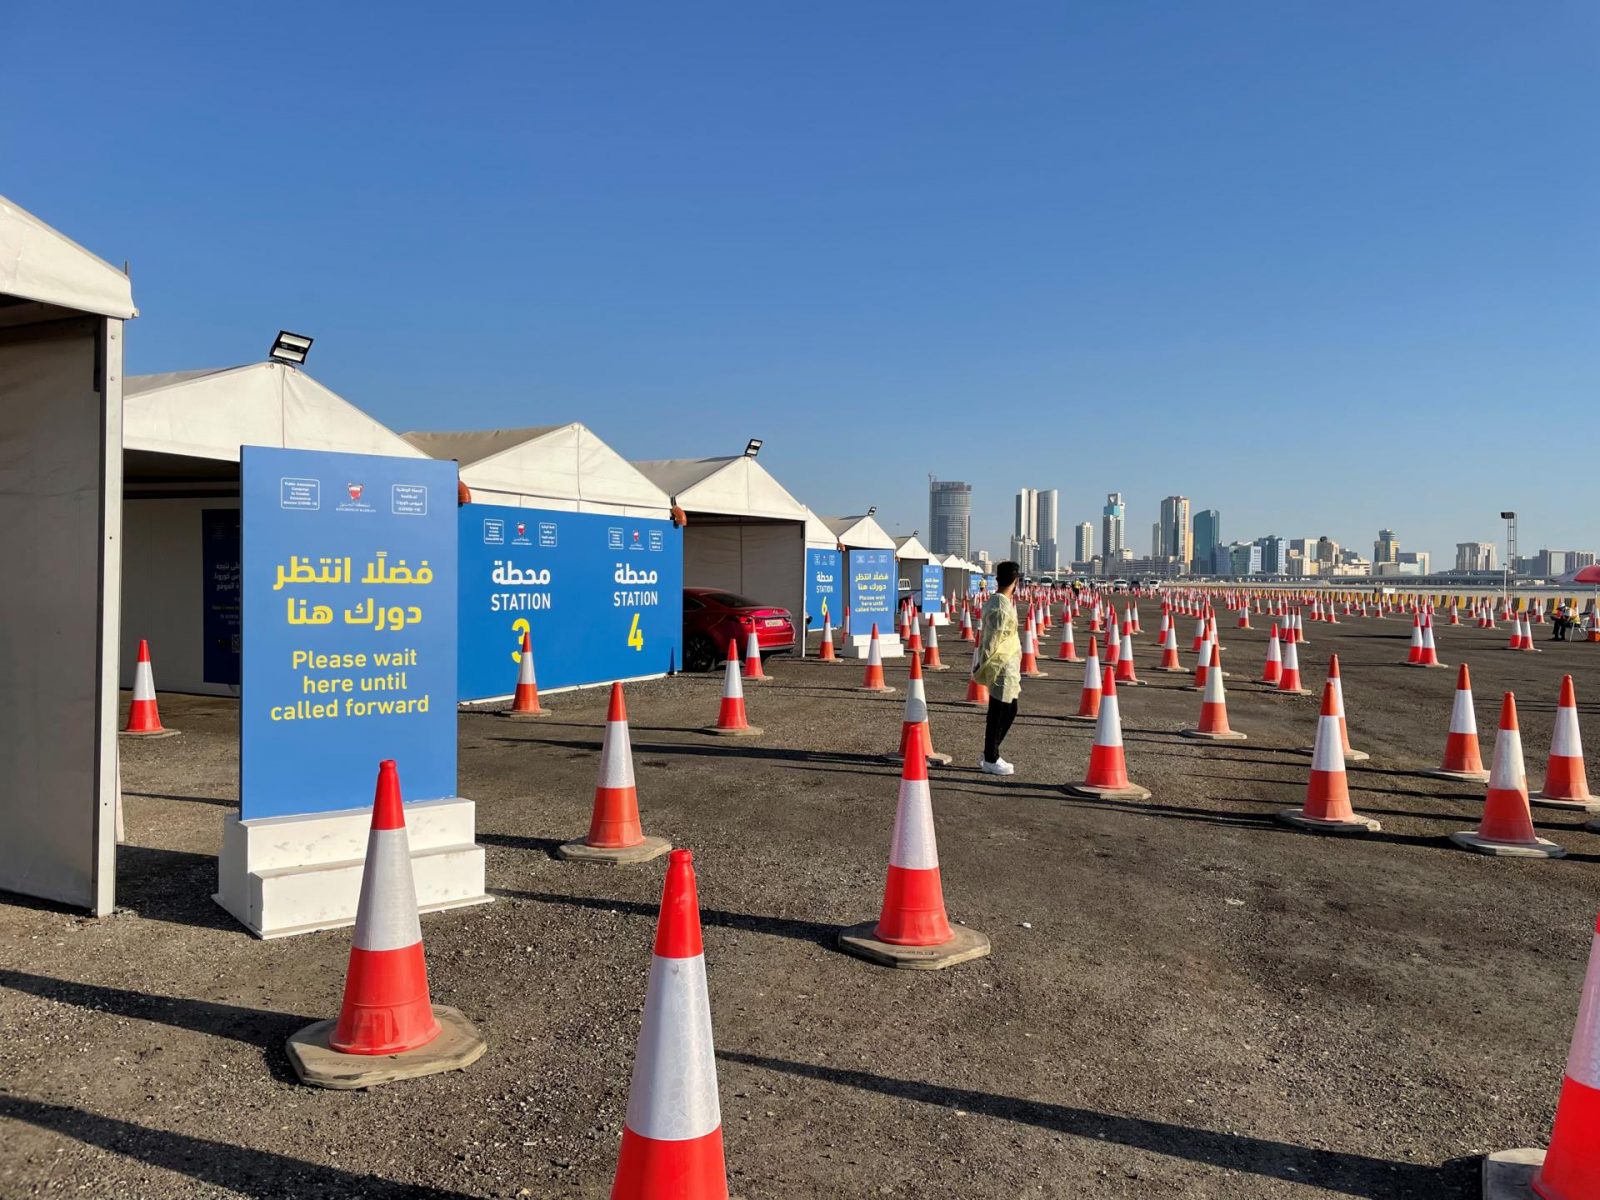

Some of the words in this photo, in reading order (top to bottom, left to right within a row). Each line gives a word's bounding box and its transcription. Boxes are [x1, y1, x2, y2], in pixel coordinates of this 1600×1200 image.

[273, 555, 351, 590] انتظر
[492, 560, 551, 585] محطة
[614, 563, 658, 584] محطة
[816, 571, 833, 582] محطة
[613, 591, 658, 607] STATION
[816, 585, 833, 594] STATION
[287, 598, 334, 624] هنا
[491, 592, 551, 611] STATION
[821, 596, 828, 616] 6
[344, 598, 422, 631] دورك
[511, 618, 531, 664] 3
[627, 613, 643, 651] 4
[292, 650, 367, 669] Please
[373, 648, 417, 667] wait
[303, 675, 354, 694] here
[360, 672, 407, 691] until
[270, 699, 338, 721] called
[345, 694, 429, 717] forward
